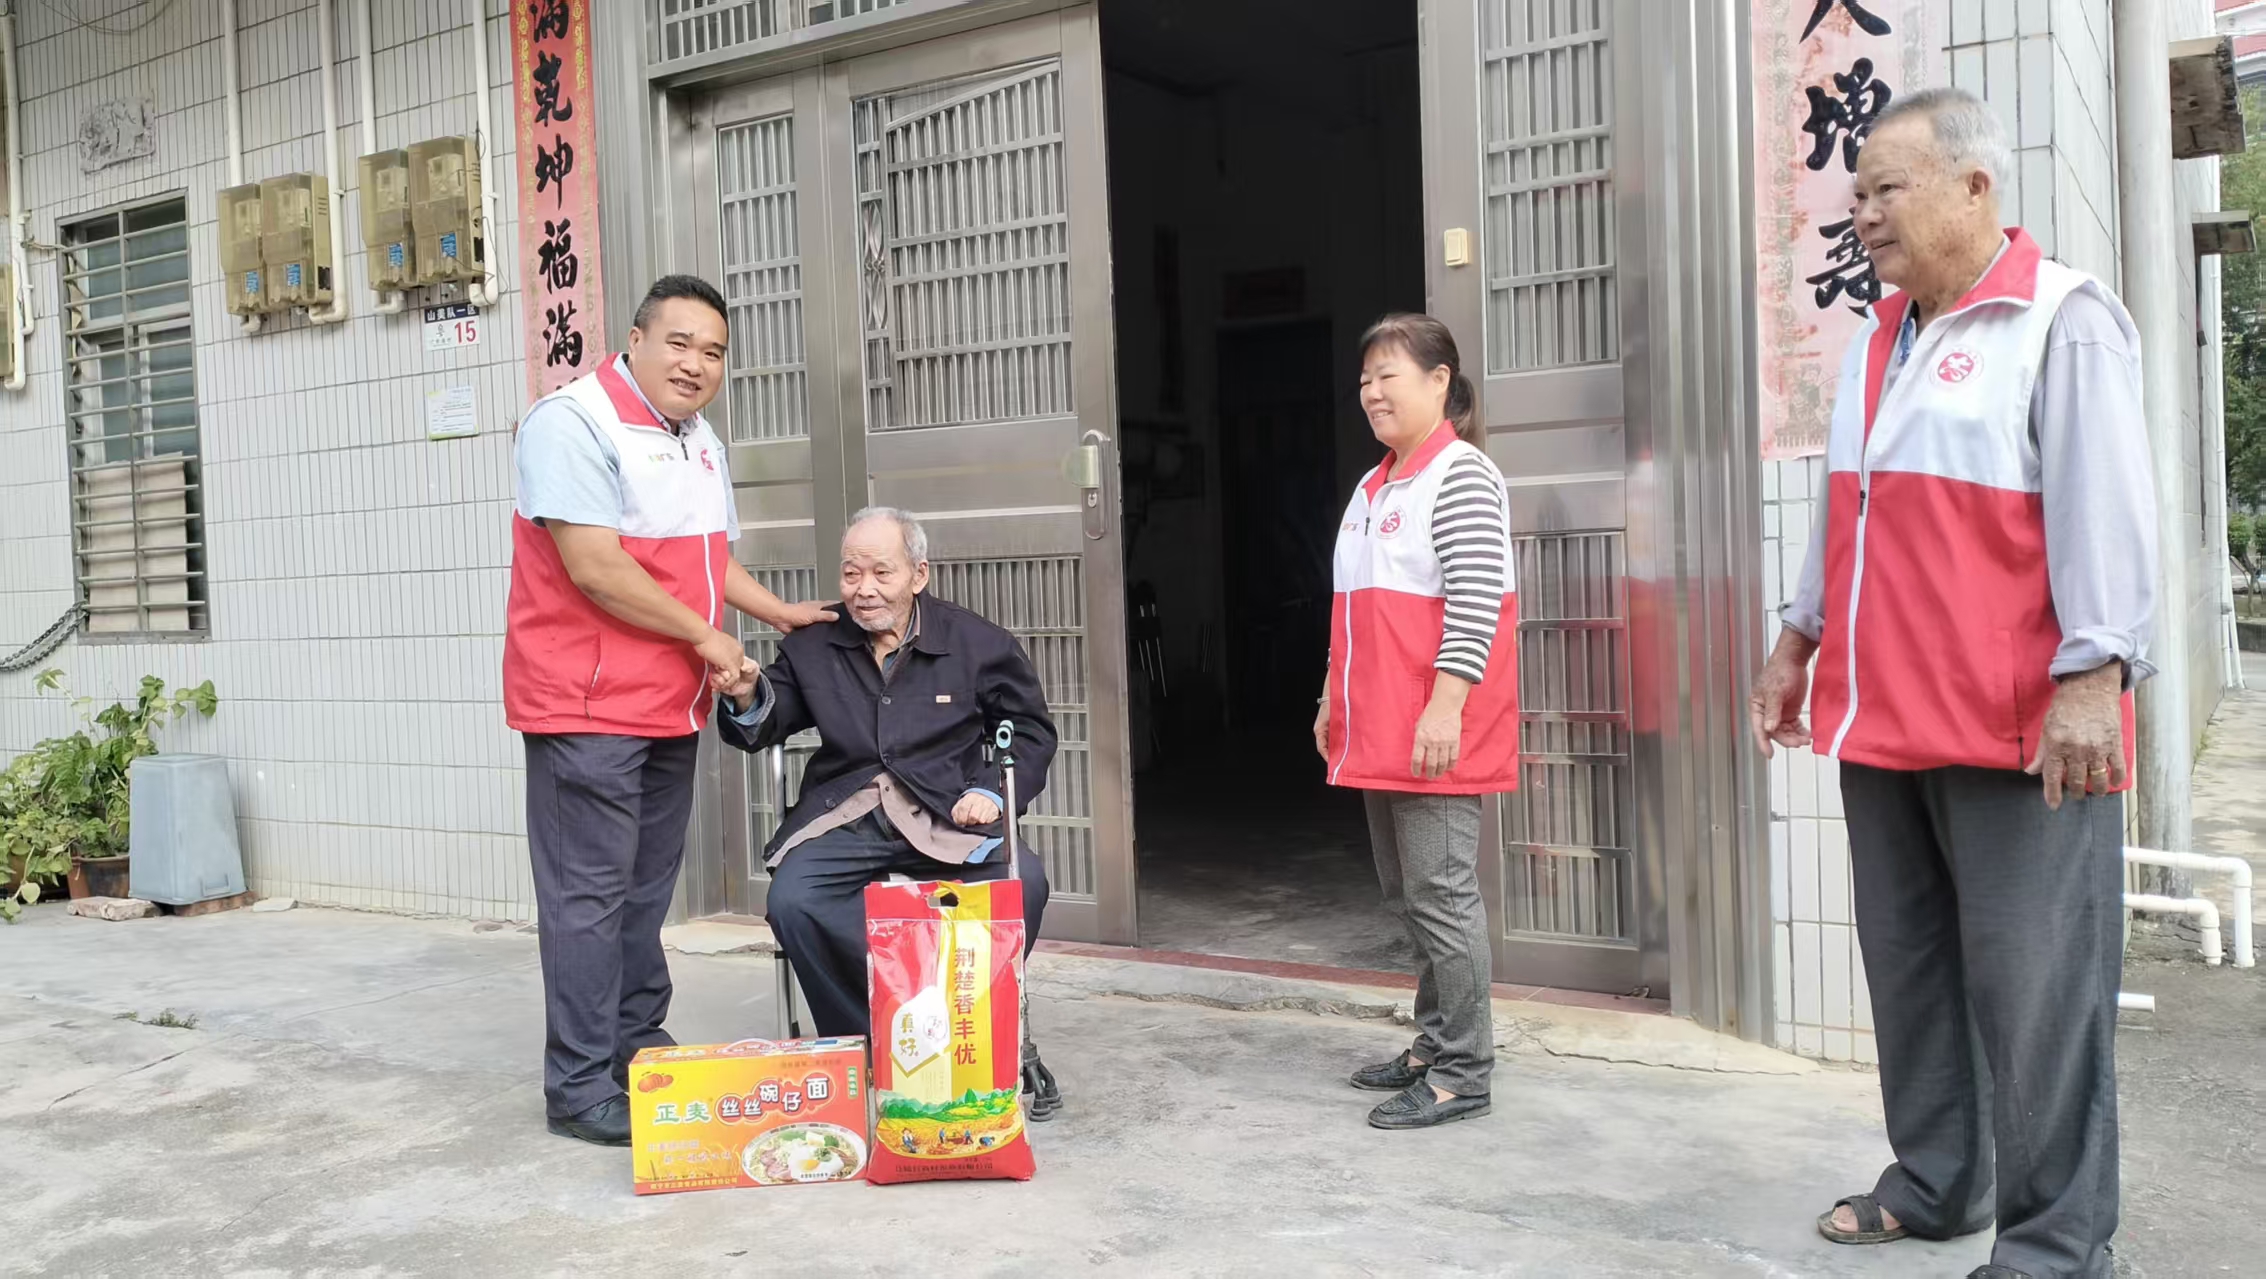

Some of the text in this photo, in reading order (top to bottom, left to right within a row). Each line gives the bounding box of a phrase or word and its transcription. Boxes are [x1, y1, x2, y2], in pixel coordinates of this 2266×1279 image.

[454, 320, 477, 344] 15
[954, 947, 977, 1065] 荆楚香丰优
[654, 1101, 711, 1123] 正麦
[721, 1077, 829, 1118] 丝丝碗仔面
